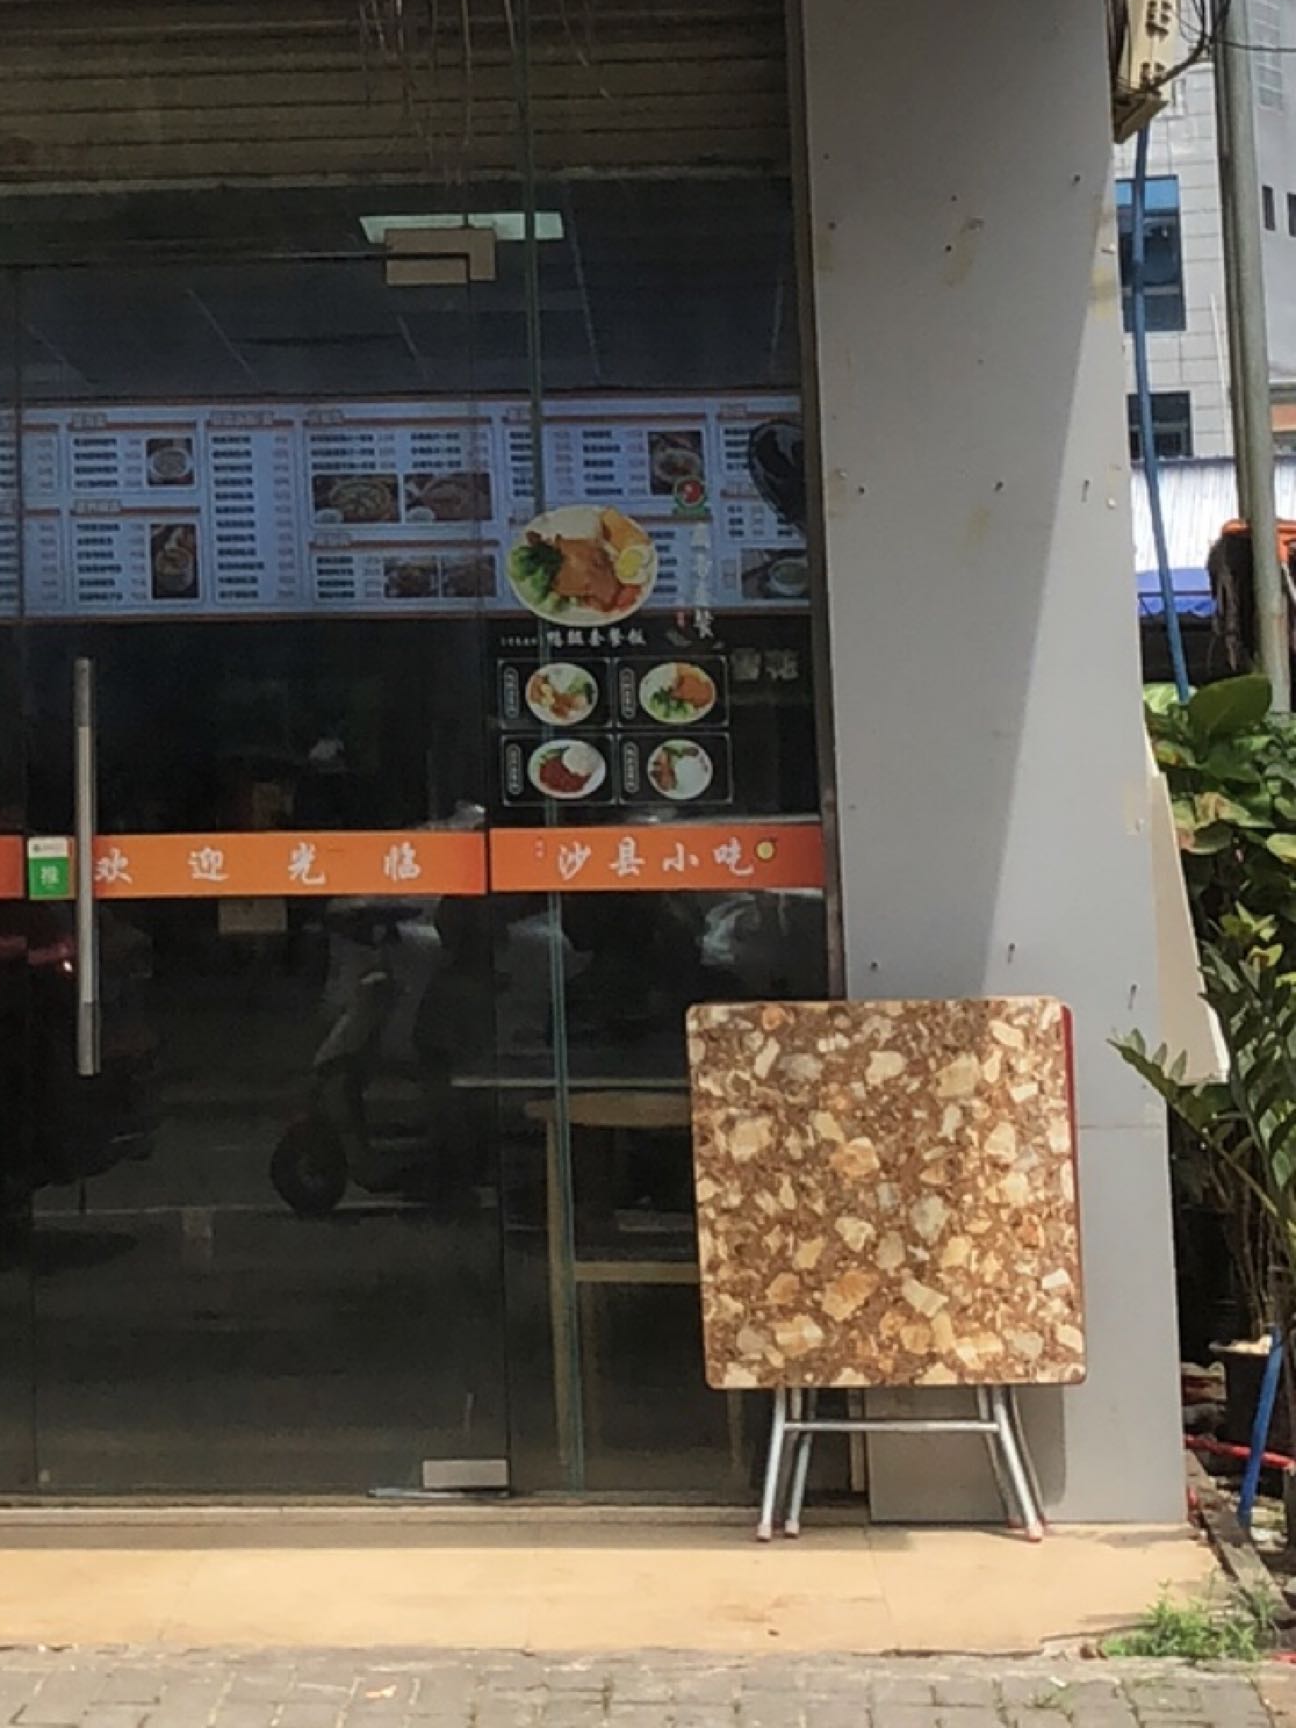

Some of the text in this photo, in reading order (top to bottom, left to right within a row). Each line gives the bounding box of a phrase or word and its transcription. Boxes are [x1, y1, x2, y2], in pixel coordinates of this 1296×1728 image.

[94, 842, 422, 886] 欢迎光临
[557, 836, 754, 880] 沙县小吃
